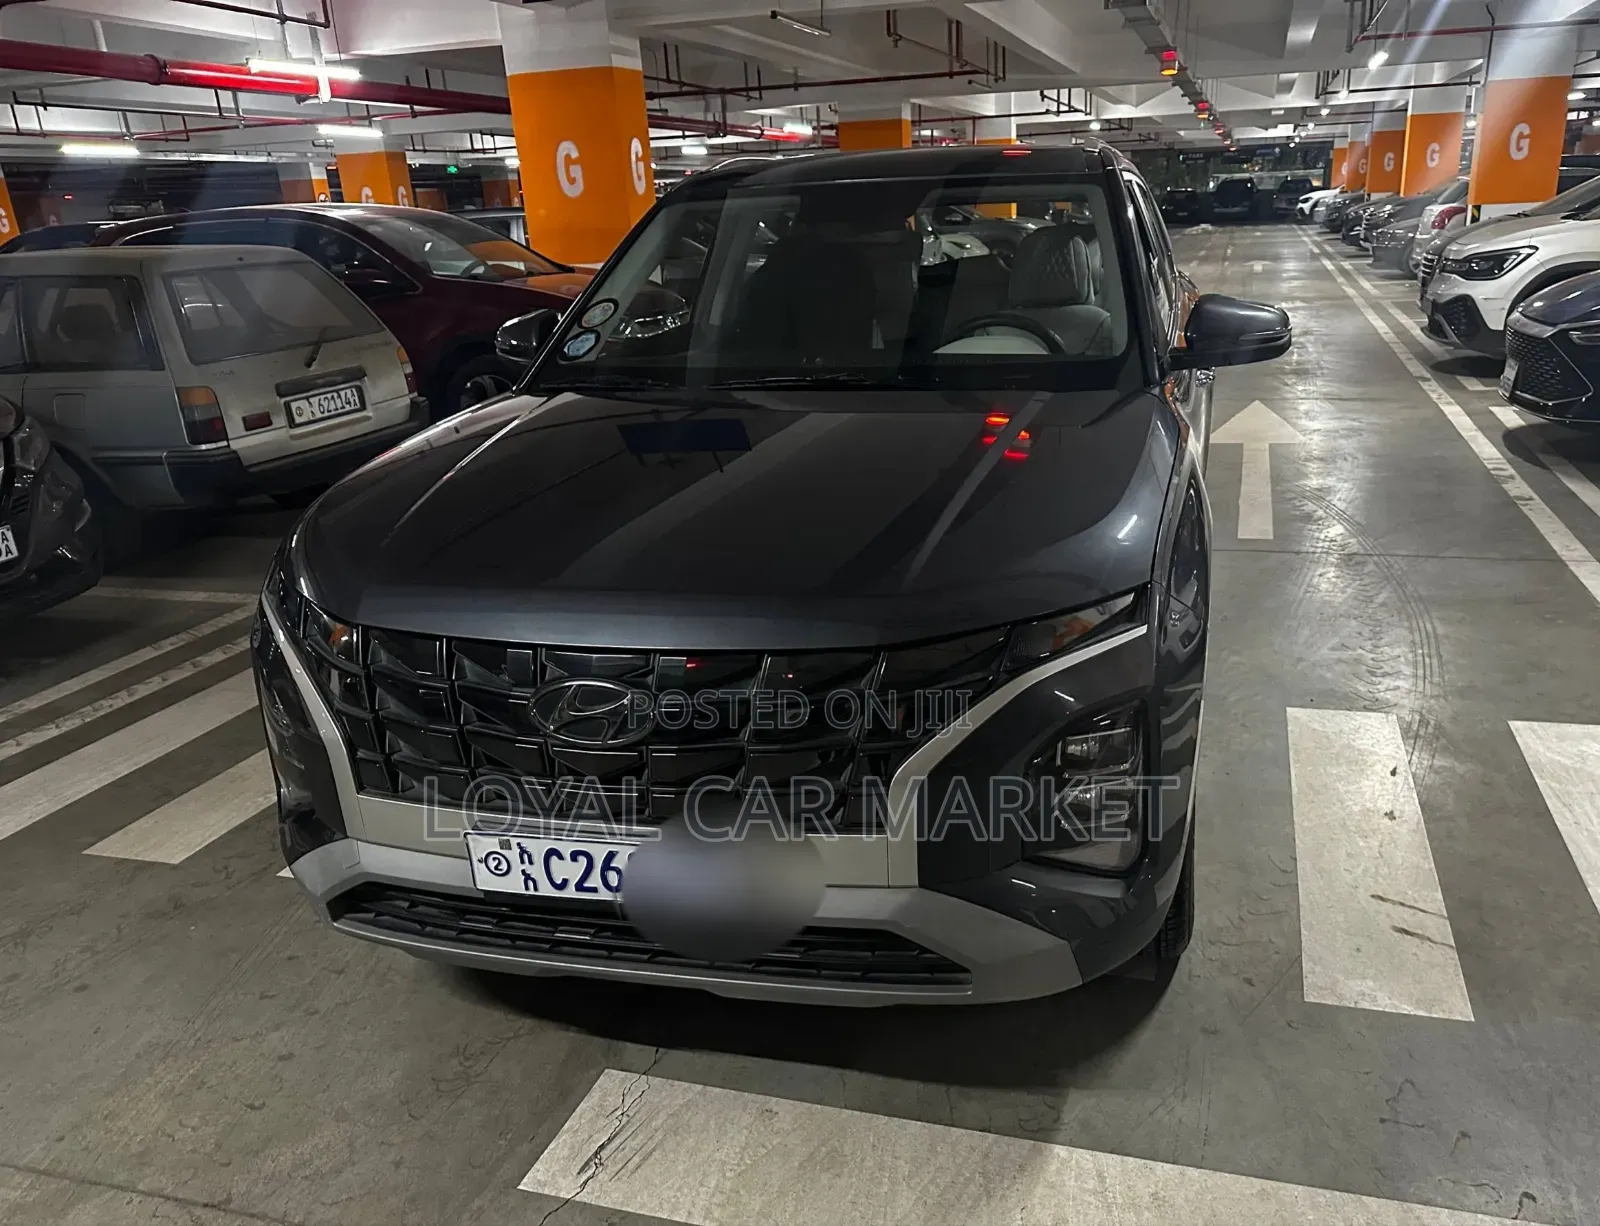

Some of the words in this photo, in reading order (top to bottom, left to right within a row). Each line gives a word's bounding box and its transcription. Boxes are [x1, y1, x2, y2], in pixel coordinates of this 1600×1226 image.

[1510, 122, 1531, 160] G
[631, 137, 646, 195] G
[1359, 158, 1367, 174] G
[1384, 152, 1395, 172] G
[1426, 142, 1440, 168] G
[556, 140, 584, 198] G
[318, 391, 351, 414] 62114
[1, 531, 9, 544] A
[5, 544, 13, 557] A
[543, 846, 632, 895] C26
